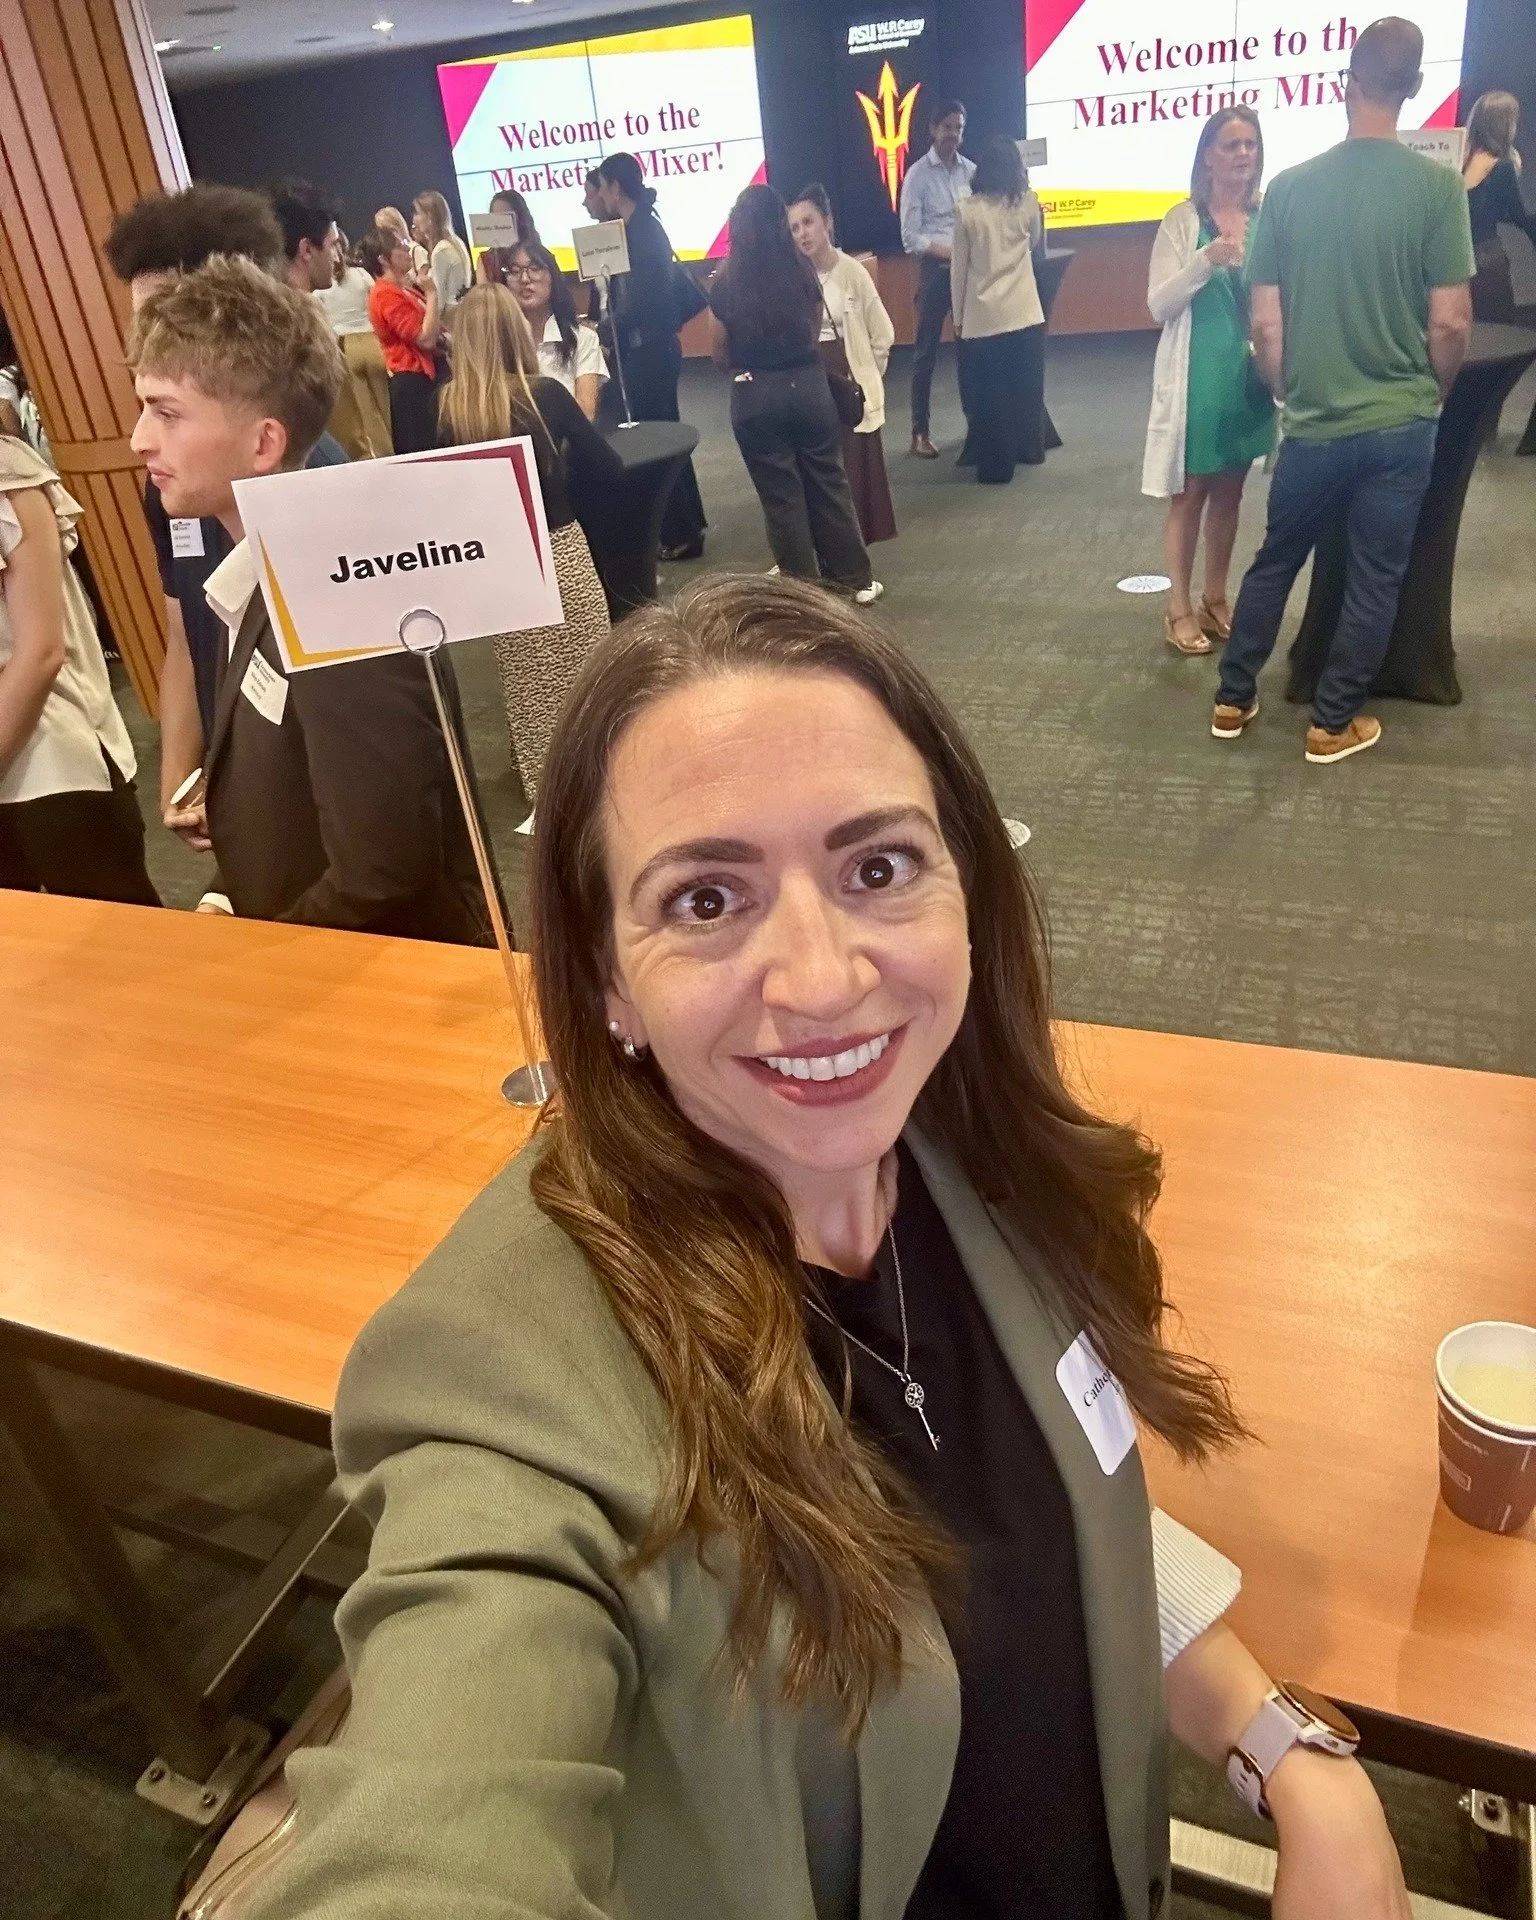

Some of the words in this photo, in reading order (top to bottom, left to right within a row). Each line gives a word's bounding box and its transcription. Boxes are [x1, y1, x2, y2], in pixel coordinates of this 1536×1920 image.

[848, 23, 877, 45] ASU
[1096, 35, 1259, 76] Welcome
[1273, 26, 1307, 57] to
[1322, 17, 1358, 52] th
[1073, 83, 1261, 130] Marketing
[1274, 72, 1346, 109] Mix
[497, 119, 616, 152] Welcome
[624, 110, 649, 136] to
[658, 102, 700, 131] the
[490, 158, 600, 193] Marketi
[632, 141, 725, 178] Mixer!
[1040, 201, 1057, 213] SU
[1075, 199, 1096, 207] Carey
[330, 540, 486, 584] Javelina
[1083, 1369, 1112, 1407] Cathe
